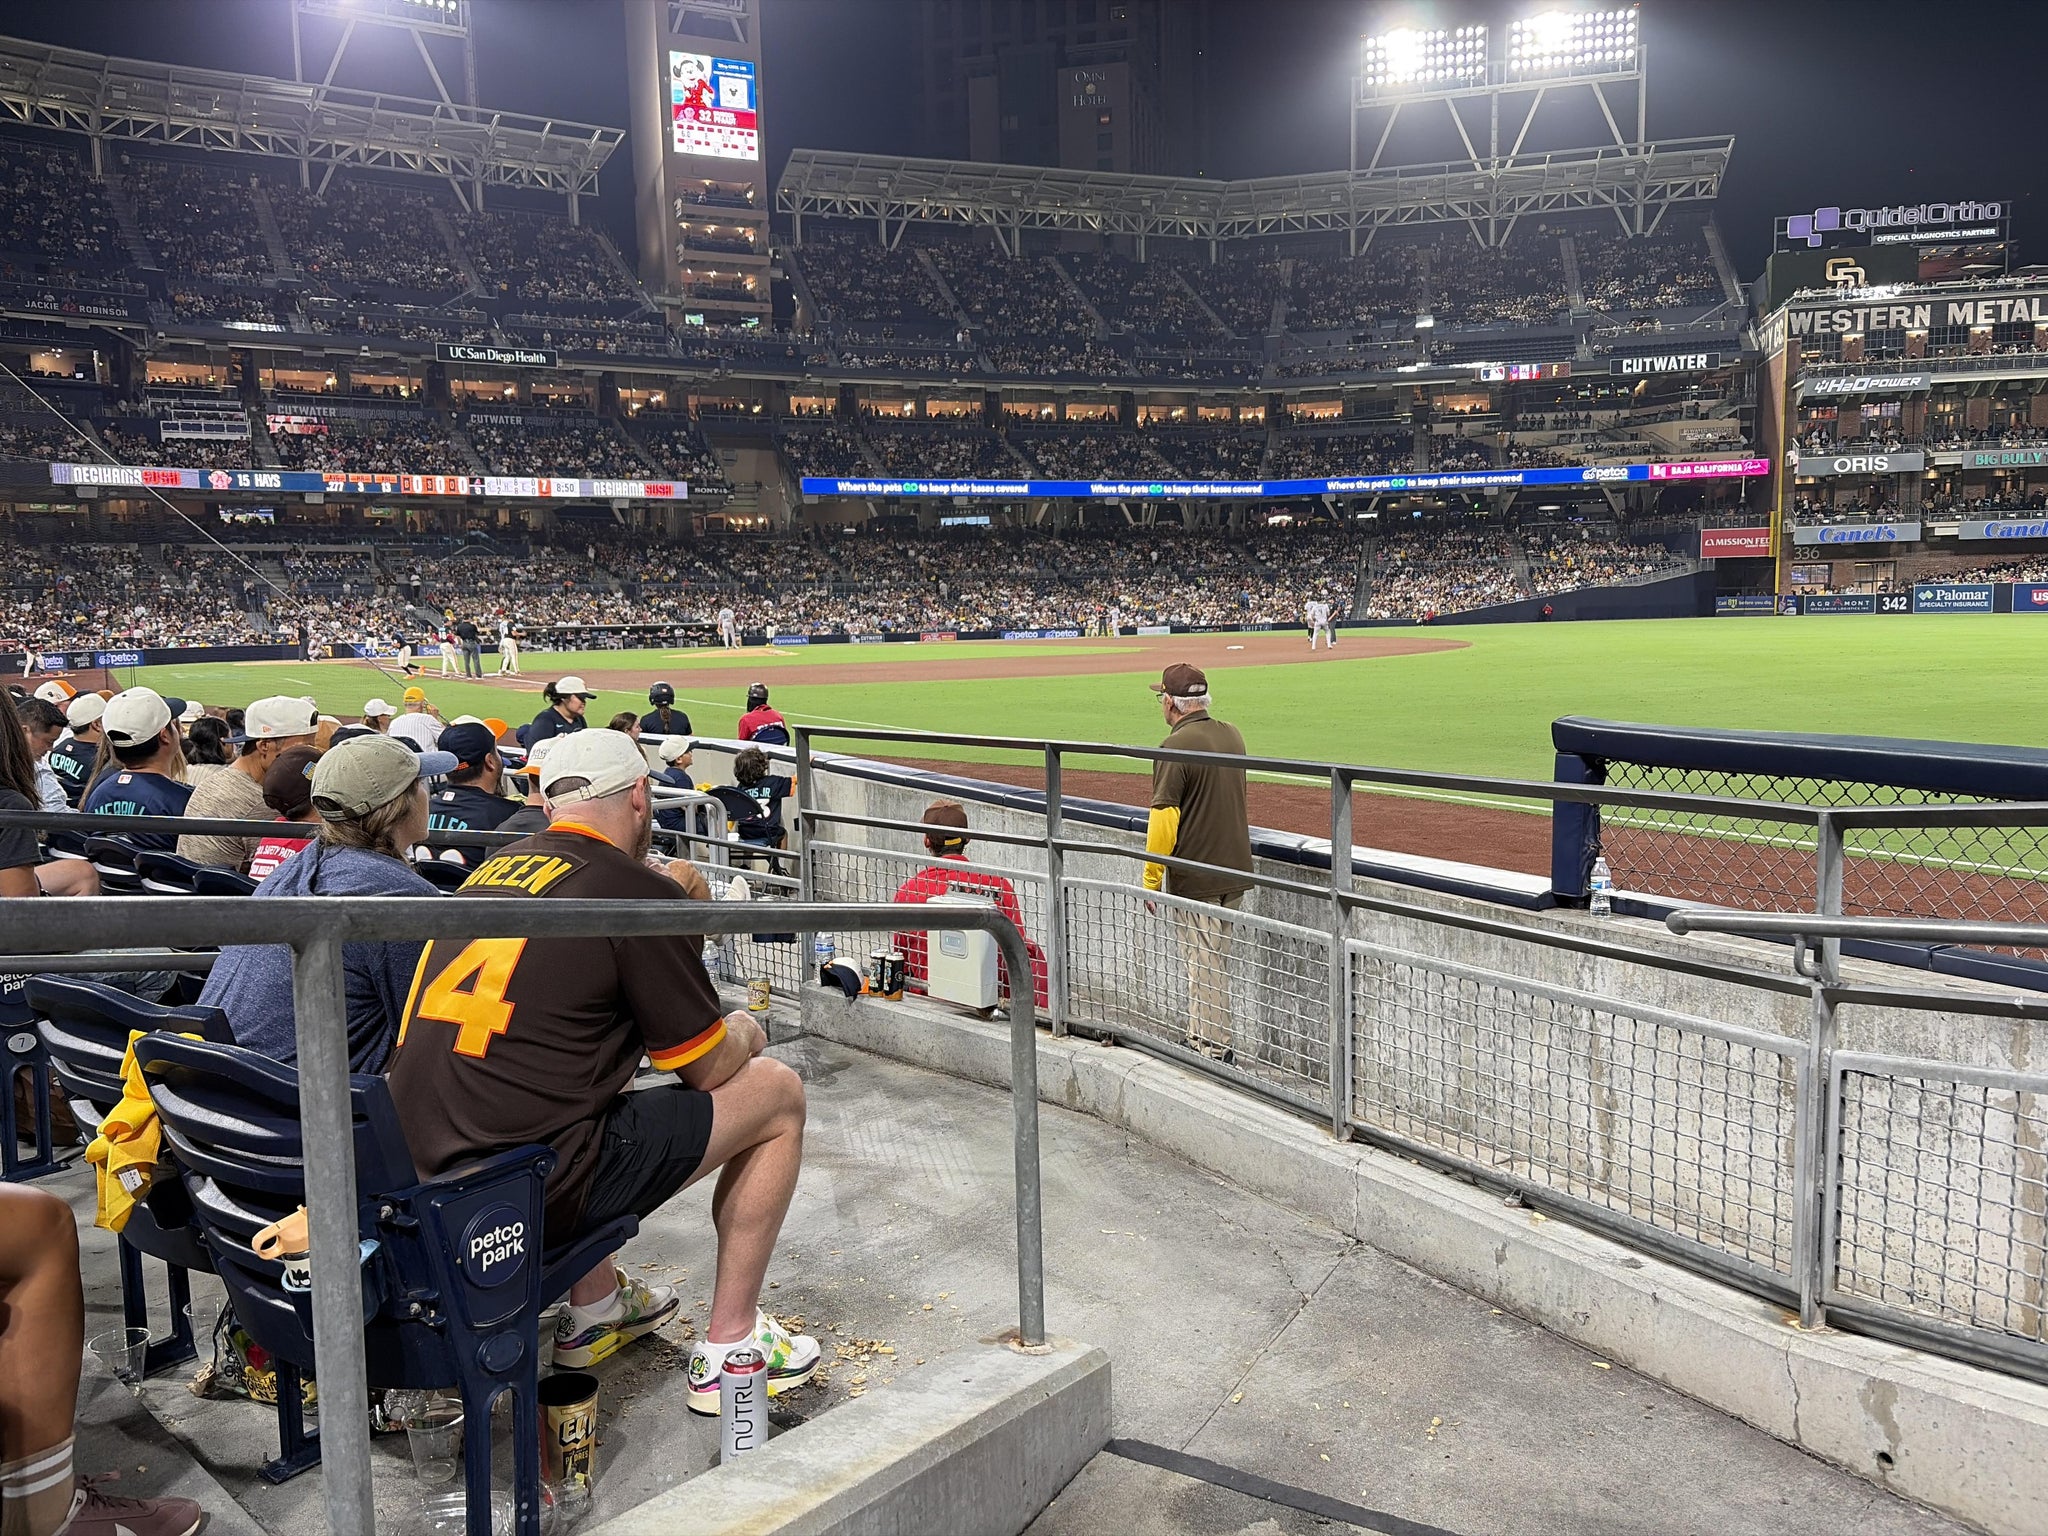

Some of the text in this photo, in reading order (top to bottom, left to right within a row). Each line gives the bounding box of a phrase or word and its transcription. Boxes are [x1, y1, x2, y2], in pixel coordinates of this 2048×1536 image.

[1845, 201, 2001, 232] QuidelOrtho
[1877, 228, 1996, 243] OFFICIAL DIAGNOSTICS PARTNER
[25, 301, 59, 310] JACKIE
[79, 306, 128, 316] ROBINSON
[1789, 298, 2048, 334] WESTERN METAL
[449, 346, 546, 364] UC San Diego Health
[1622, 354, 1707, 373] CUTWATER
[277, 405, 336, 417] CUTWATER
[470, 414, 522, 425] CUTWATER
[1833, 457, 1888, 473] ORIS
[1975, 452, 2041, 466] BIG BULLY
[1596, 468, 1628, 479] petco
[1671, 467, 1691, 475] BAJA
[1694, 463, 1743, 473] CALIFORNIA
[237, 474, 281, 488] 15 HAYS
[556, 483, 575, 492] 8:50
[837, 481, 866, 492] Where
[867, 482, 882, 492] the
[903, 483, 918, 492] GO
[919, 483, 928, 492] to
[951, 483, 970, 493] their
[996, 484, 1028, 493] covered
[1327, 481, 1355, 490] Where
[1356, 480, 1370, 490] the
[1391, 478, 1405, 488] GO
[1407, 478, 1416, 488] to
[1440, 476, 1460, 486] their
[1487, 473, 1522, 483] covered
[1091, 484, 1116, 494] Where
[1118, 484, 1131, 494] the
[1150, 485, 1162, 494] GO
[1163, 484, 1172, 494] to
[1192, 484, 1210, 494] their
[1232, 484, 1262, 494] covered
[1818, 525, 1896, 543] Canel's
[1715, 537, 1754, 547] MISSION
[1794, 546, 1820, 560] 336
[1936, 589, 1988, 600] Palomar
[1810, 598, 1870, 607] AGRAMONT
[1882, 596, 1907, 611] 342
[1015, 630, 1038, 640] petco
[1055, 629, 1078, 639] petco
[46, 655, 64, 668] petco
[111, 653, 138, 664] petco
[4, 980, 26, 995] par
[19, 1037, 25, 1047] 7
[471, 1222, 524, 1259] petco
[482, 1238, 525, 1272] park
